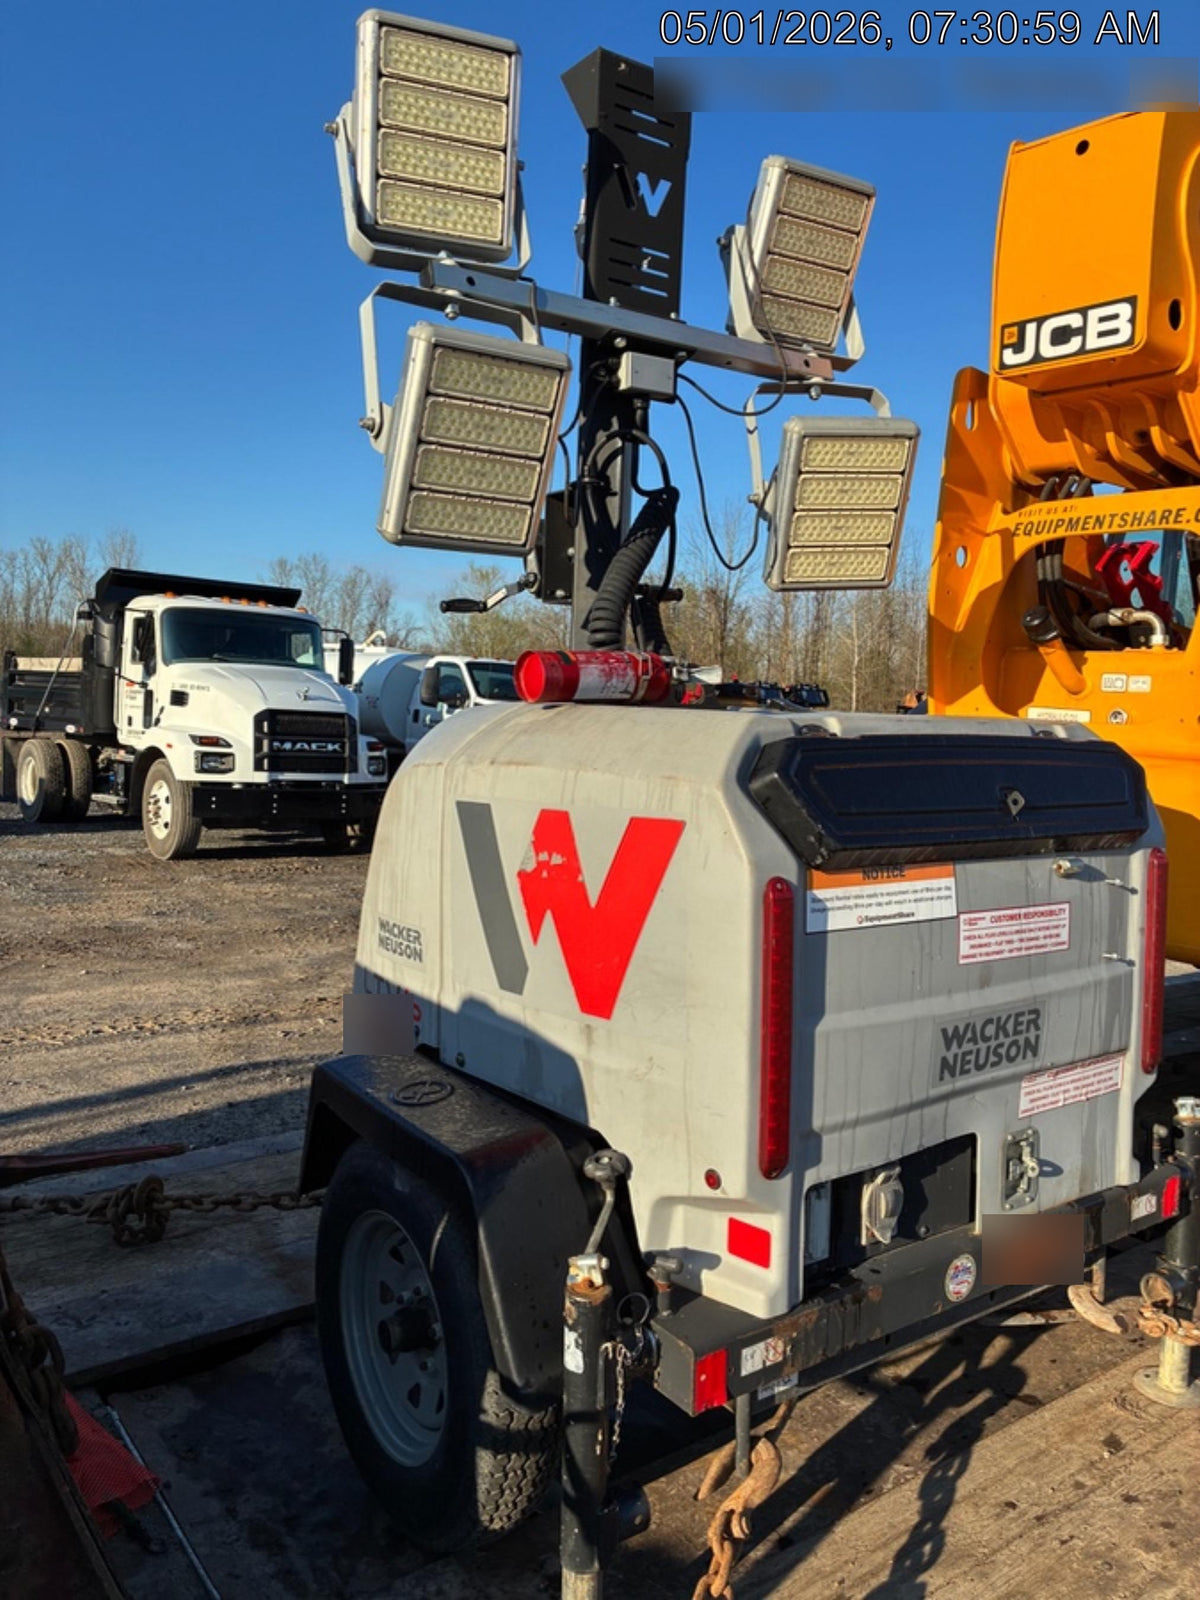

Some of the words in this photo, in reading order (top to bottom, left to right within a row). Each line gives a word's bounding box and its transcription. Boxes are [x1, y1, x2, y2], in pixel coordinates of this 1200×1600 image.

[1002, 302, 1133, 366] JCB
[272, 741, 342, 753] MACK
[941, 1008, 1041, 1052] WACKER
[939, 1033, 1041, 1082] NEUSON
